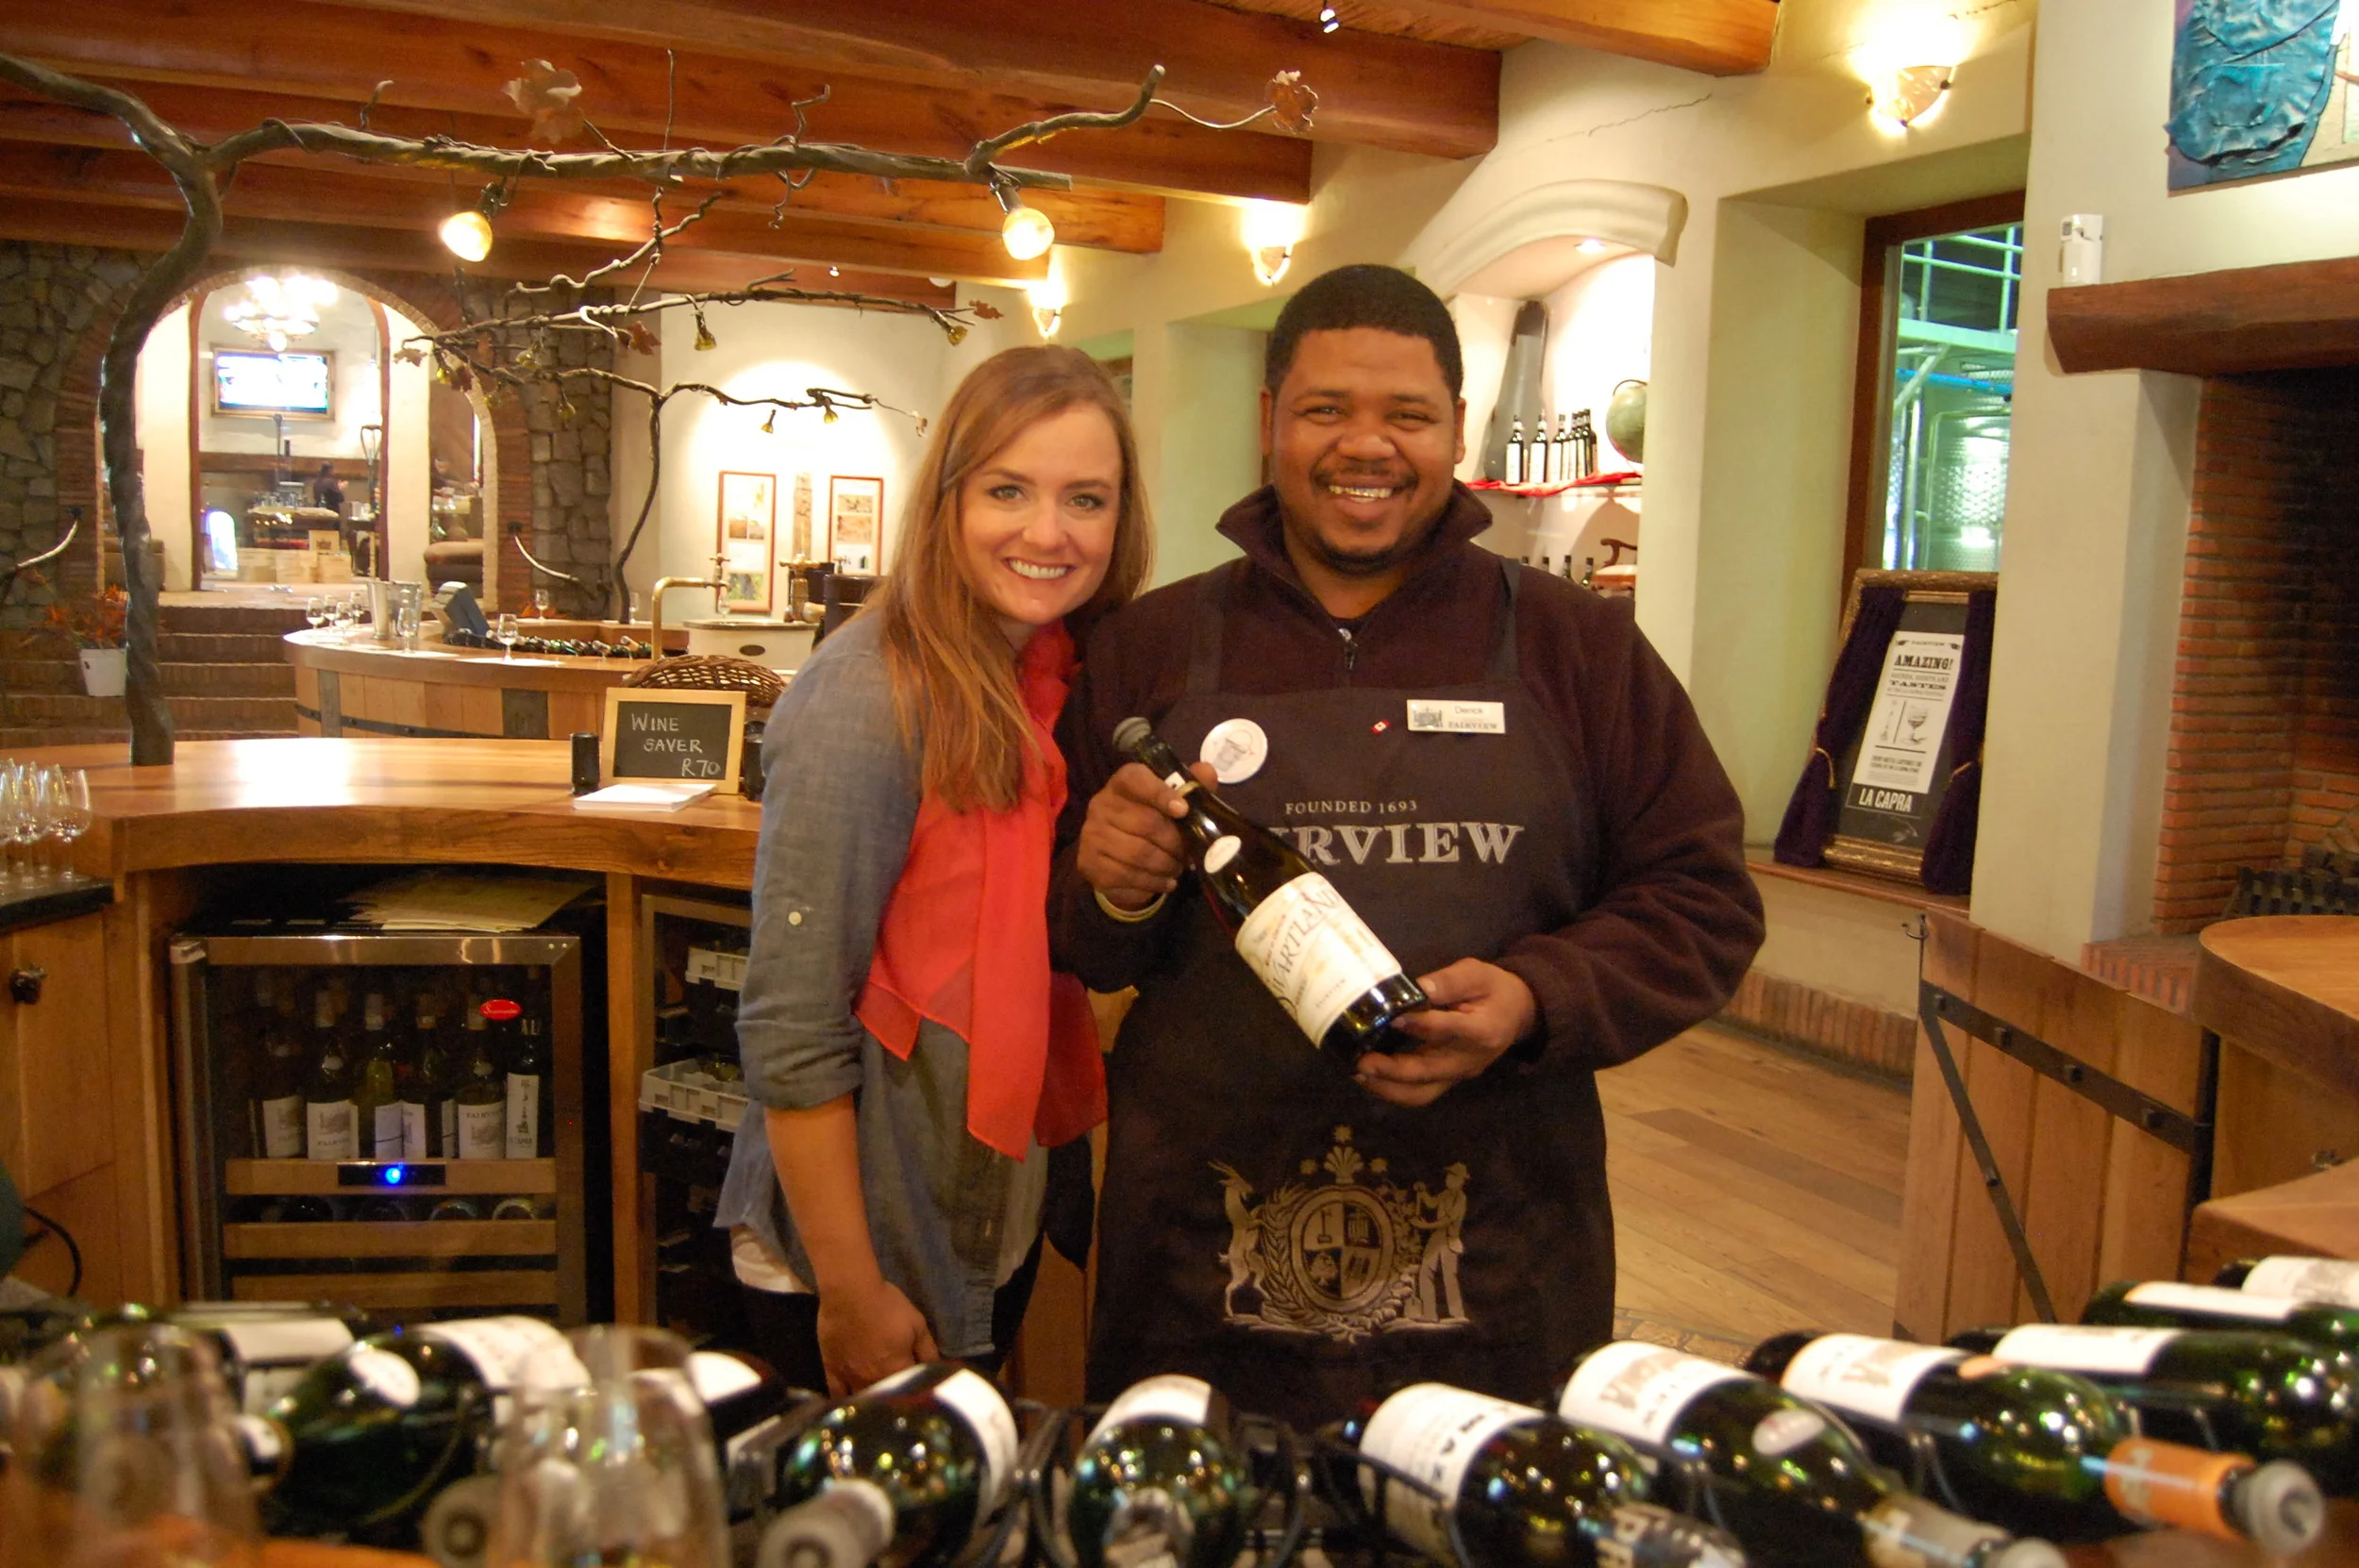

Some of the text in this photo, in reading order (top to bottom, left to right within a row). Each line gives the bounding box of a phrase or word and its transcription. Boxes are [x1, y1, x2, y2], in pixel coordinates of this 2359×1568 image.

[1894, 654, 1954, 670] AMAZING!
[1890, 680, 1946, 690] TASTES
[631, 712, 679, 731] WINE
[1447, 721, 1497, 729] FAIRVIEW
[644, 738, 703, 754] SAVER
[681, 758, 721, 777] R70
[1285, 800, 1417, 814] FOUNDED 1693
[1858, 788, 1913, 812] LA CAPRA
[1268, 821, 1525, 866] RVIEW
